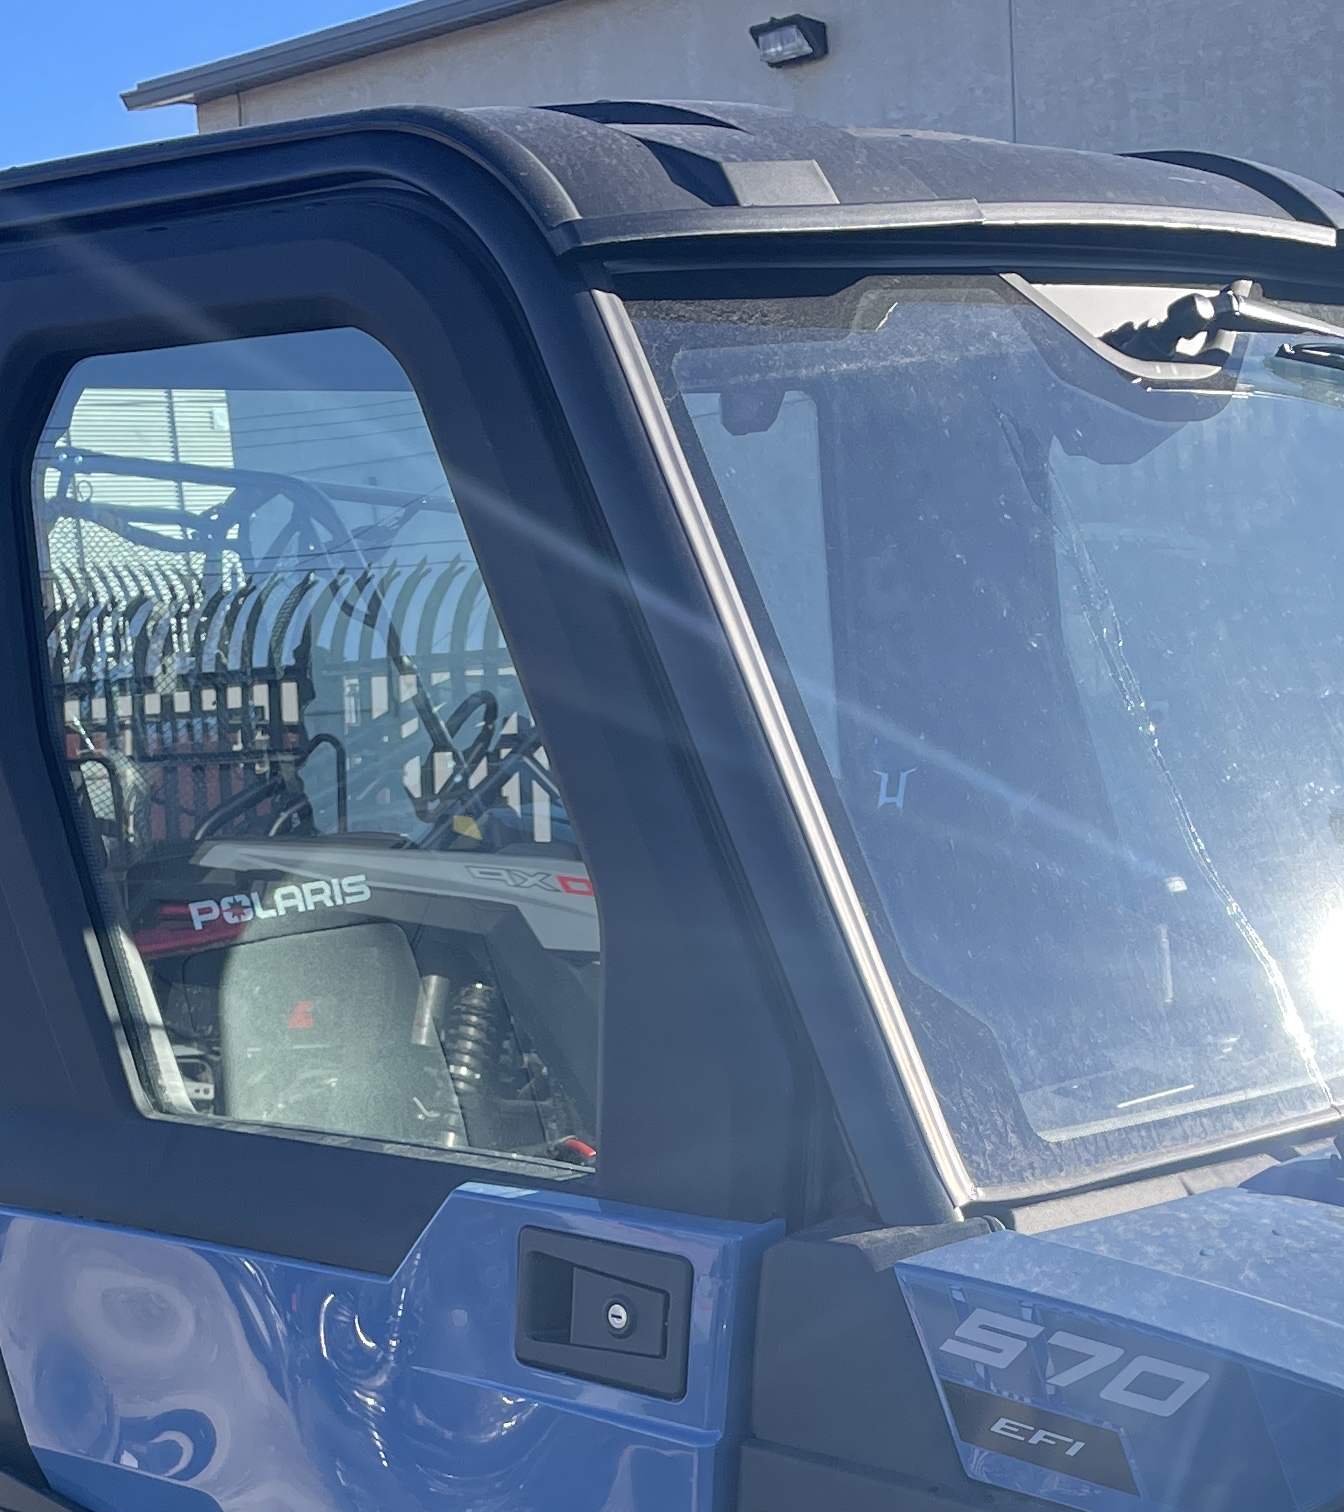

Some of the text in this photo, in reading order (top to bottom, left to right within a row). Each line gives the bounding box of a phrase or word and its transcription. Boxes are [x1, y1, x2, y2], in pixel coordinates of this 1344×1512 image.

[187, 873, 373, 931] POLARIS
[937, 1307, 1210, 1418] 570
[989, 1416, 1086, 1457] EFI
